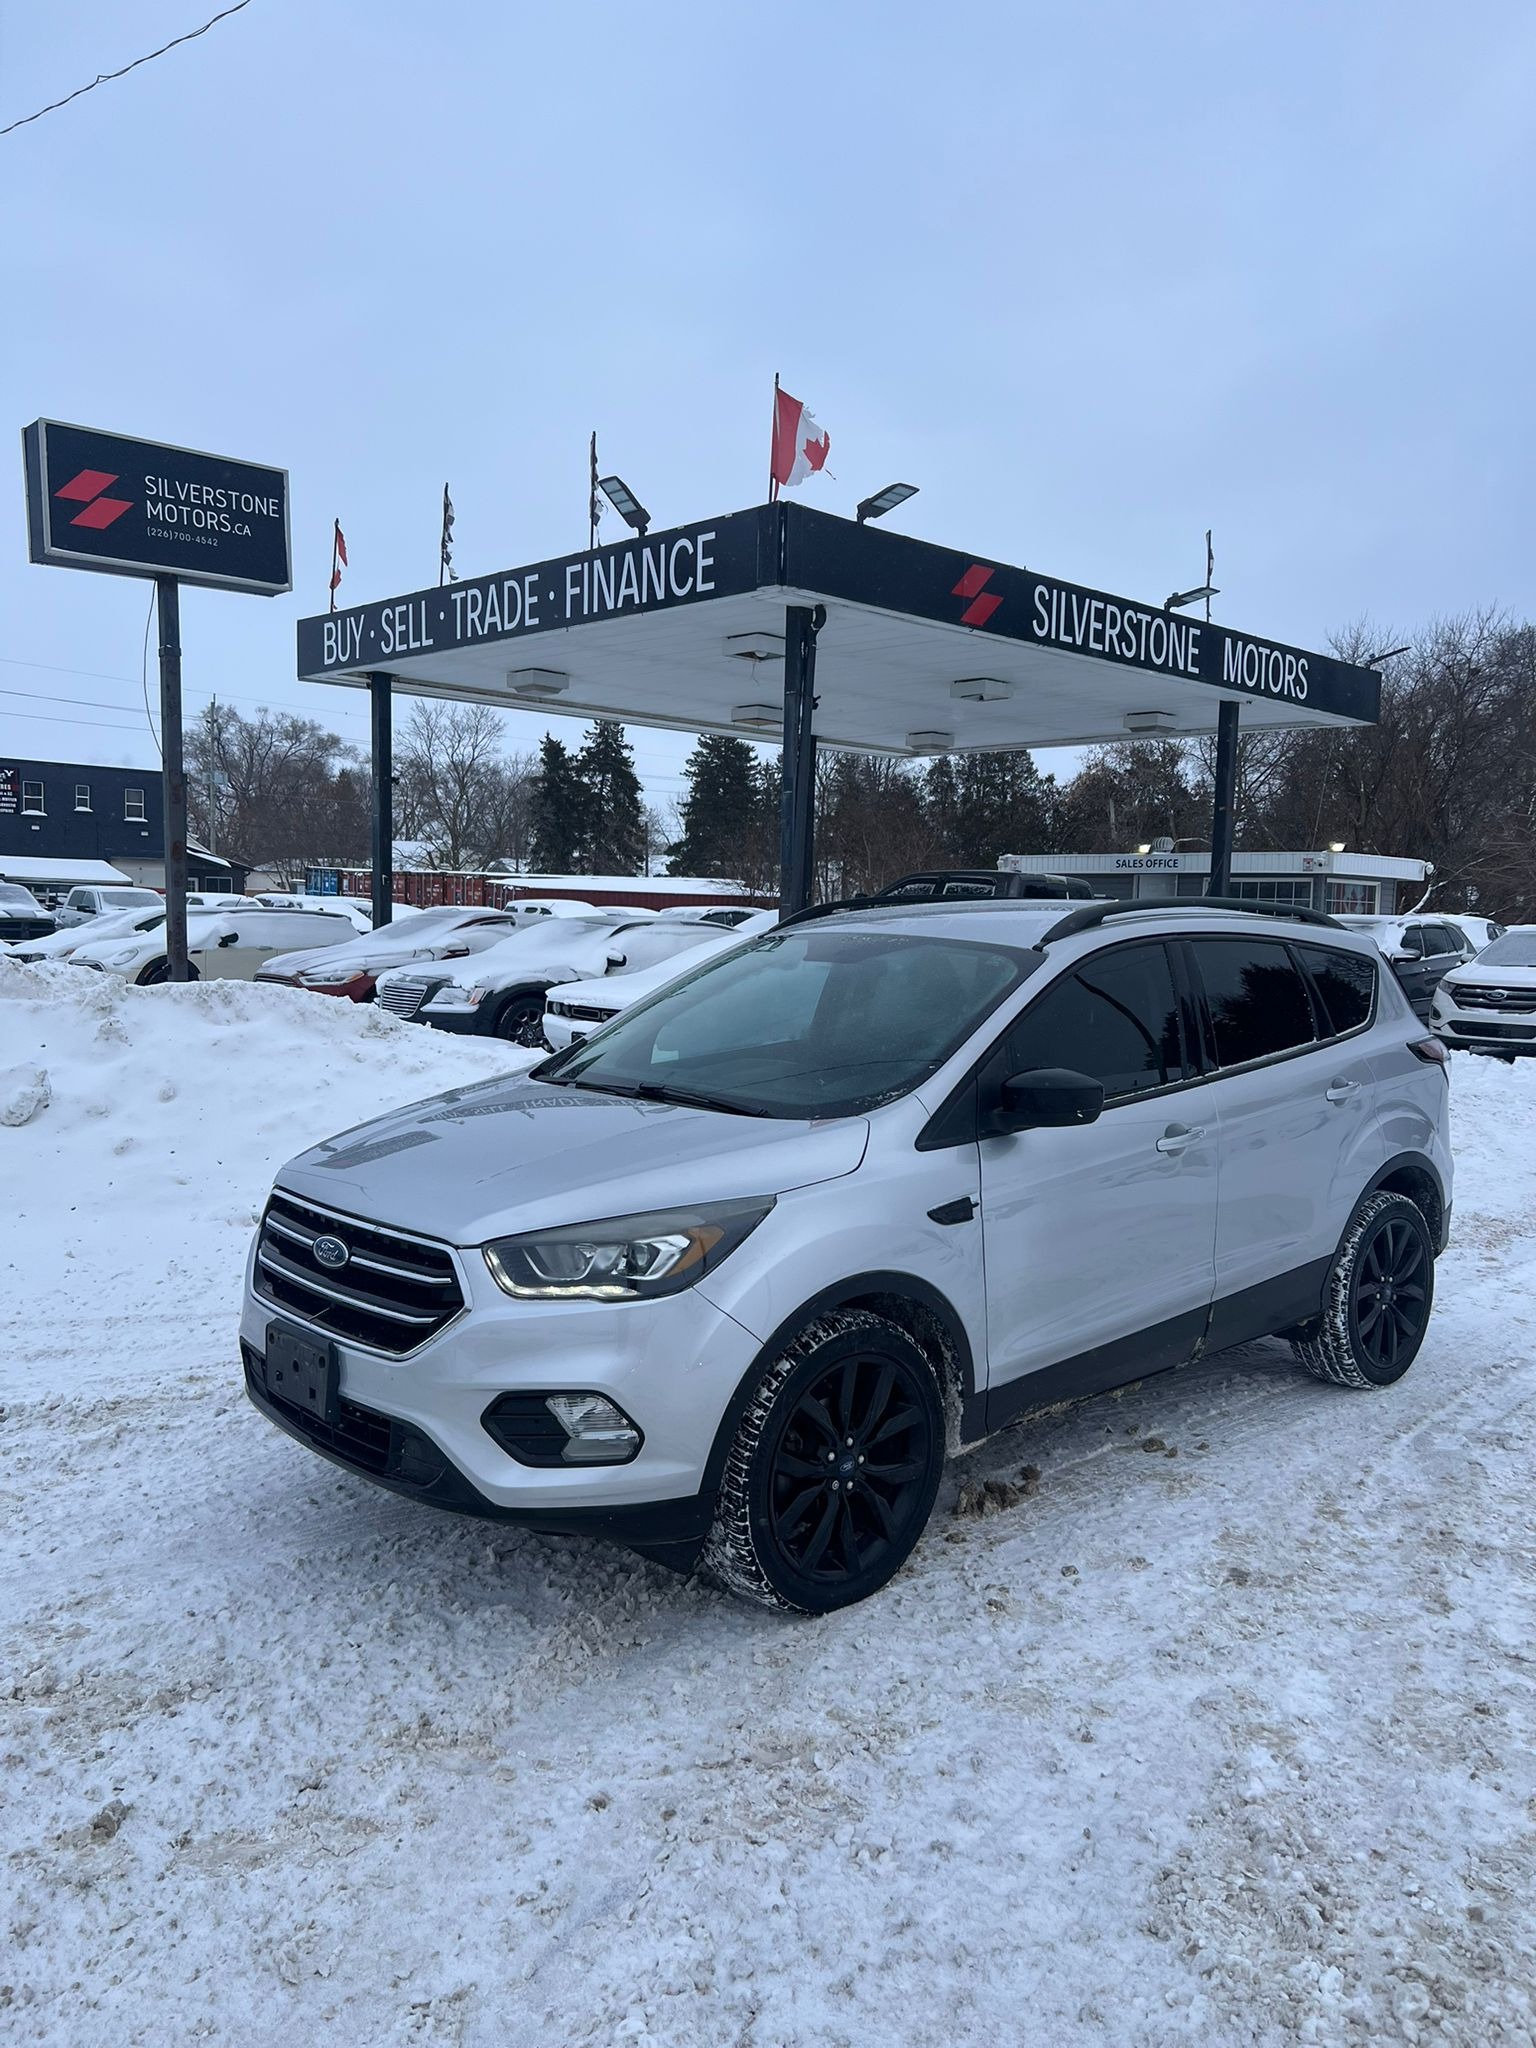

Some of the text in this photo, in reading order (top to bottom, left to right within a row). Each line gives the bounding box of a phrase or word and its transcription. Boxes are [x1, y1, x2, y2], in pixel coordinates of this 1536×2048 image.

[145, 475, 280, 518] SILVERSTONE
[146, 526, 219, 547] (226)700-4542
[323, 531, 717, 666] BUY SELL TRADE FINANCE
[1032, 584, 1309, 700] SILVERSTONE MOTORS
[1115, 858, 1179, 869] SALES OFFICE
[319, 1240, 339, 1261] Ford
